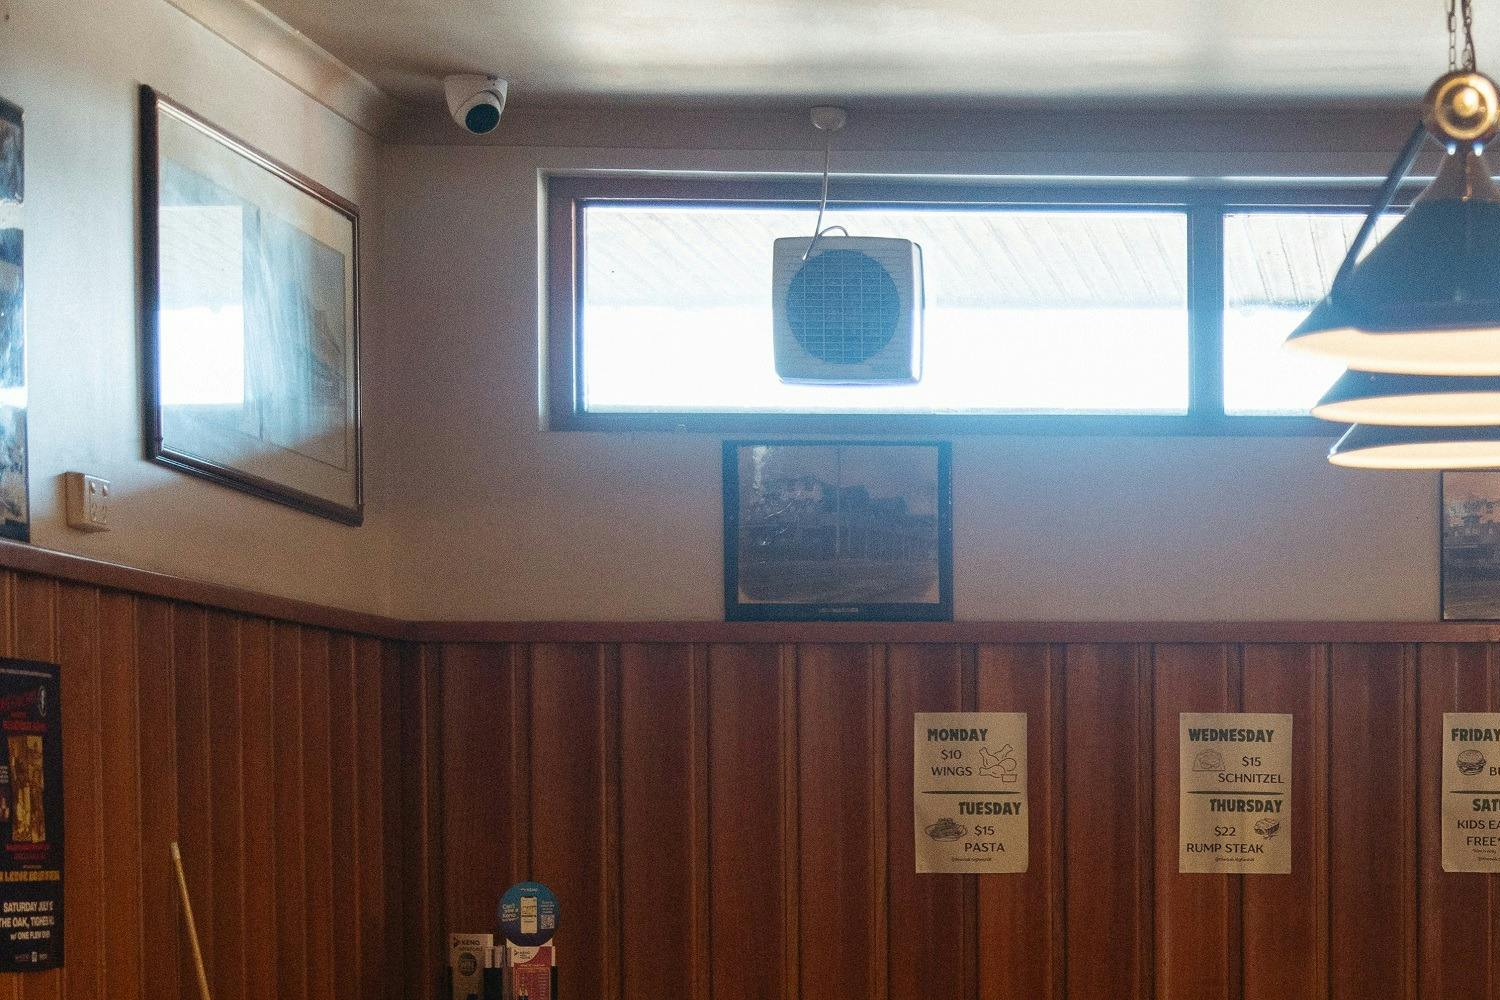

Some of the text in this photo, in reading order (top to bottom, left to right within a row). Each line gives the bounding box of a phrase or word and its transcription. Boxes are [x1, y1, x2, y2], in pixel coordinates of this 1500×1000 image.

[927, 728, 989, 742] MONDAY
[1188, 728, 1275, 743] WEDNESDAY
[941, 749, 962, 760] $10
[1241, 756, 1262, 767] $15
[931, 766, 973, 777] WINGS
[1218, 773, 1285, 784] SCHNITZEL
[958, 801, 1022, 815] TUESDAY
[1209, 798, 1283, 813] THURSDAY
[974, 824, 995, 836] $15
[1457, 819, 1485, 830] KIDS
[1214, 825, 1236, 837] $22
[964, 842, 1005, 852] PASTA
[1186, 843, 1264, 854] RUMP STEAK
[3, 901, 37, 912] SATURDAY
[12, 917, 30, 928] OAK,
[17, 931, 29, 939] ONE
